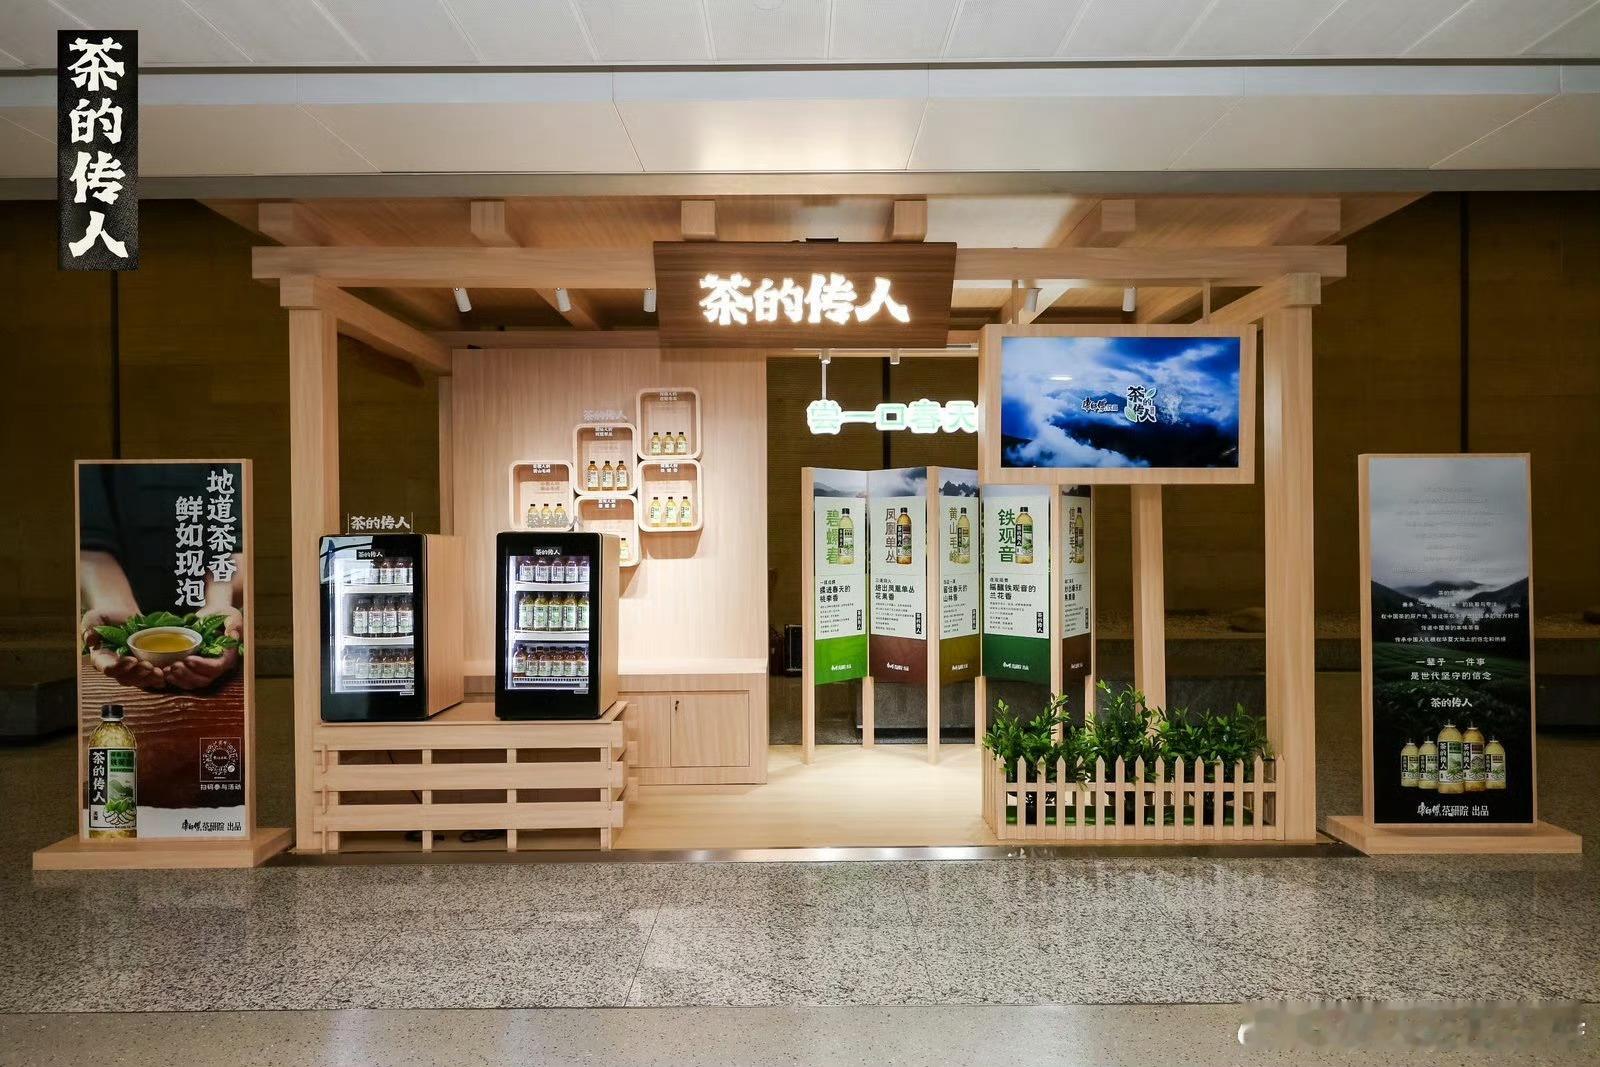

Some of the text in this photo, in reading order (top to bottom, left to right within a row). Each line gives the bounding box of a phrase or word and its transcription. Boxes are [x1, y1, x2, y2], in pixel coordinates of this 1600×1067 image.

[699, 273, 910, 326] 茶的传人
[206, 468, 238, 583] 地道茶香
[351, 515, 410, 530] 茶的传人
[826, 509, 840, 565] 碧螺春
[885, 508, 897, 560] 凤凰单丛
[997, 508, 1016, 563] 铁观音
[174, 495, 207, 608] 鲜如现泡
[1411, 671, 1492, 680] 是世代坚守的信念
[1416, 657, 1485, 666] 一辈子 一件事
[1431, 697, 1473, 708] 茶的传人
[91, 751, 105, 803] 茶的传人
[200, 783, 242, 792] 扫码参与活动
[227, 821, 242, 831] 出品
[1472, 805, 1489, 816] 出品
